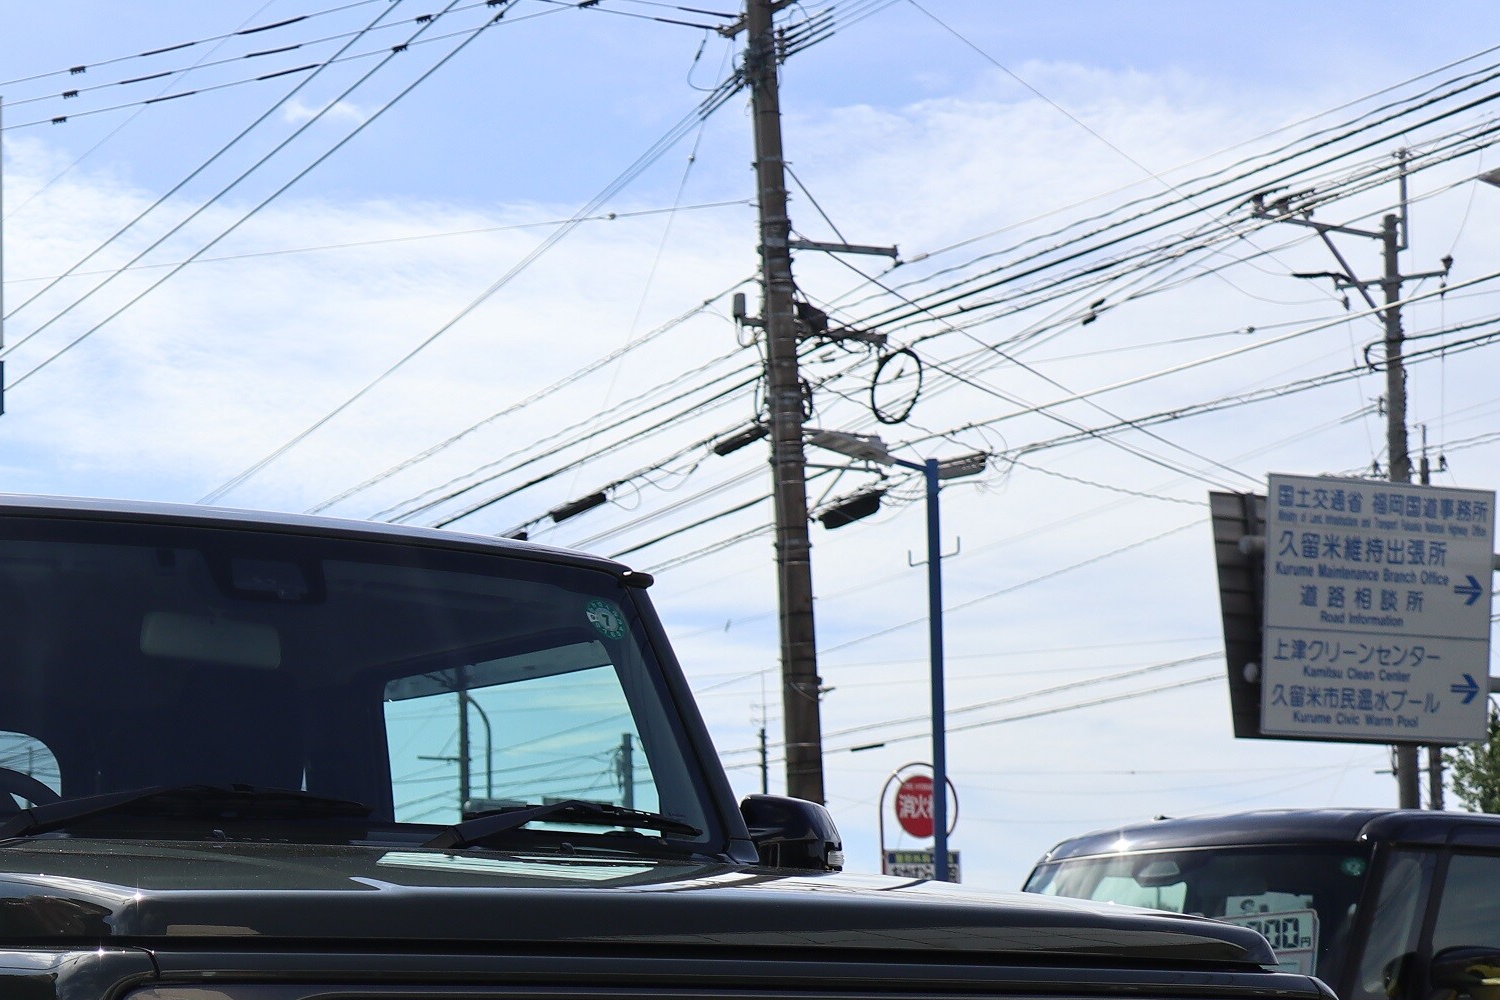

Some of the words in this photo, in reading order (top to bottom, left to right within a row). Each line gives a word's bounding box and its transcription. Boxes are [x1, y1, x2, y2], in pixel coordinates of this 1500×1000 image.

[1279, 530, 1447, 567] 久留米維持出張所
[1275, 561, 1314, 577] Kurume
[1318, 563, 1380, 582] Maintenance
[1383, 567, 1417, 585] Branch
[1421, 570, 1449, 586] Office
[1320, 610, 1344, 624] Road
[1349, 612, 1404, 627] Information
[1273, 637, 1441, 667] 上津クリーンセンター
[1348, 668, 1375, 681] Clean
[1379, 669, 1411, 683] Center
[1271, 683, 1441, 714] 久留米市民温水プール
[1293, 712, 1332, 725] Kurume
[1365, 714, 1392, 727] Warm
[1398, 716, 1419, 729] Pool
